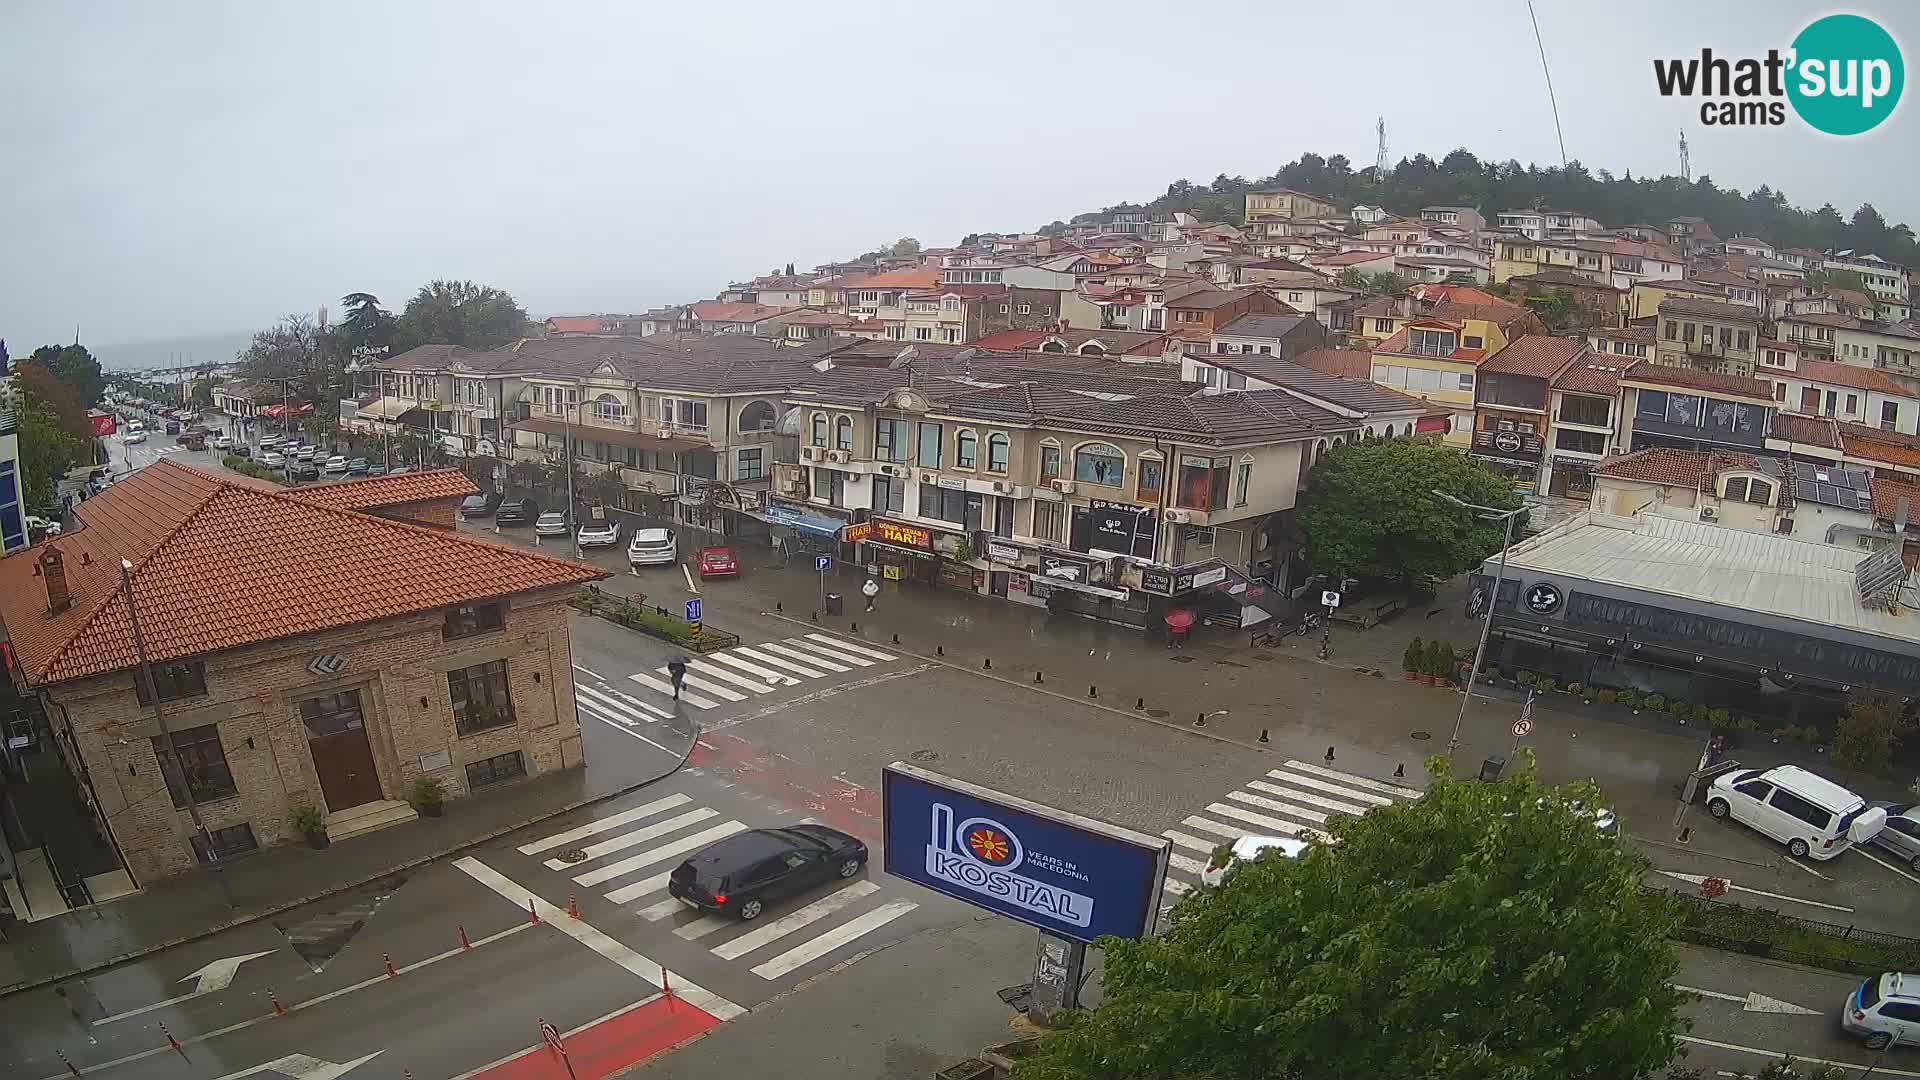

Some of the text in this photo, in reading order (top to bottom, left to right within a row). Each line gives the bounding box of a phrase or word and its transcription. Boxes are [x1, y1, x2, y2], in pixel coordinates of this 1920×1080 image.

[819, 558, 828, 569] P
[1026, 849, 1078, 871] YEARS IN
[1026, 857, 1090, 883] MACEDONIA
[936, 851, 1081, 921] KOSTAL
